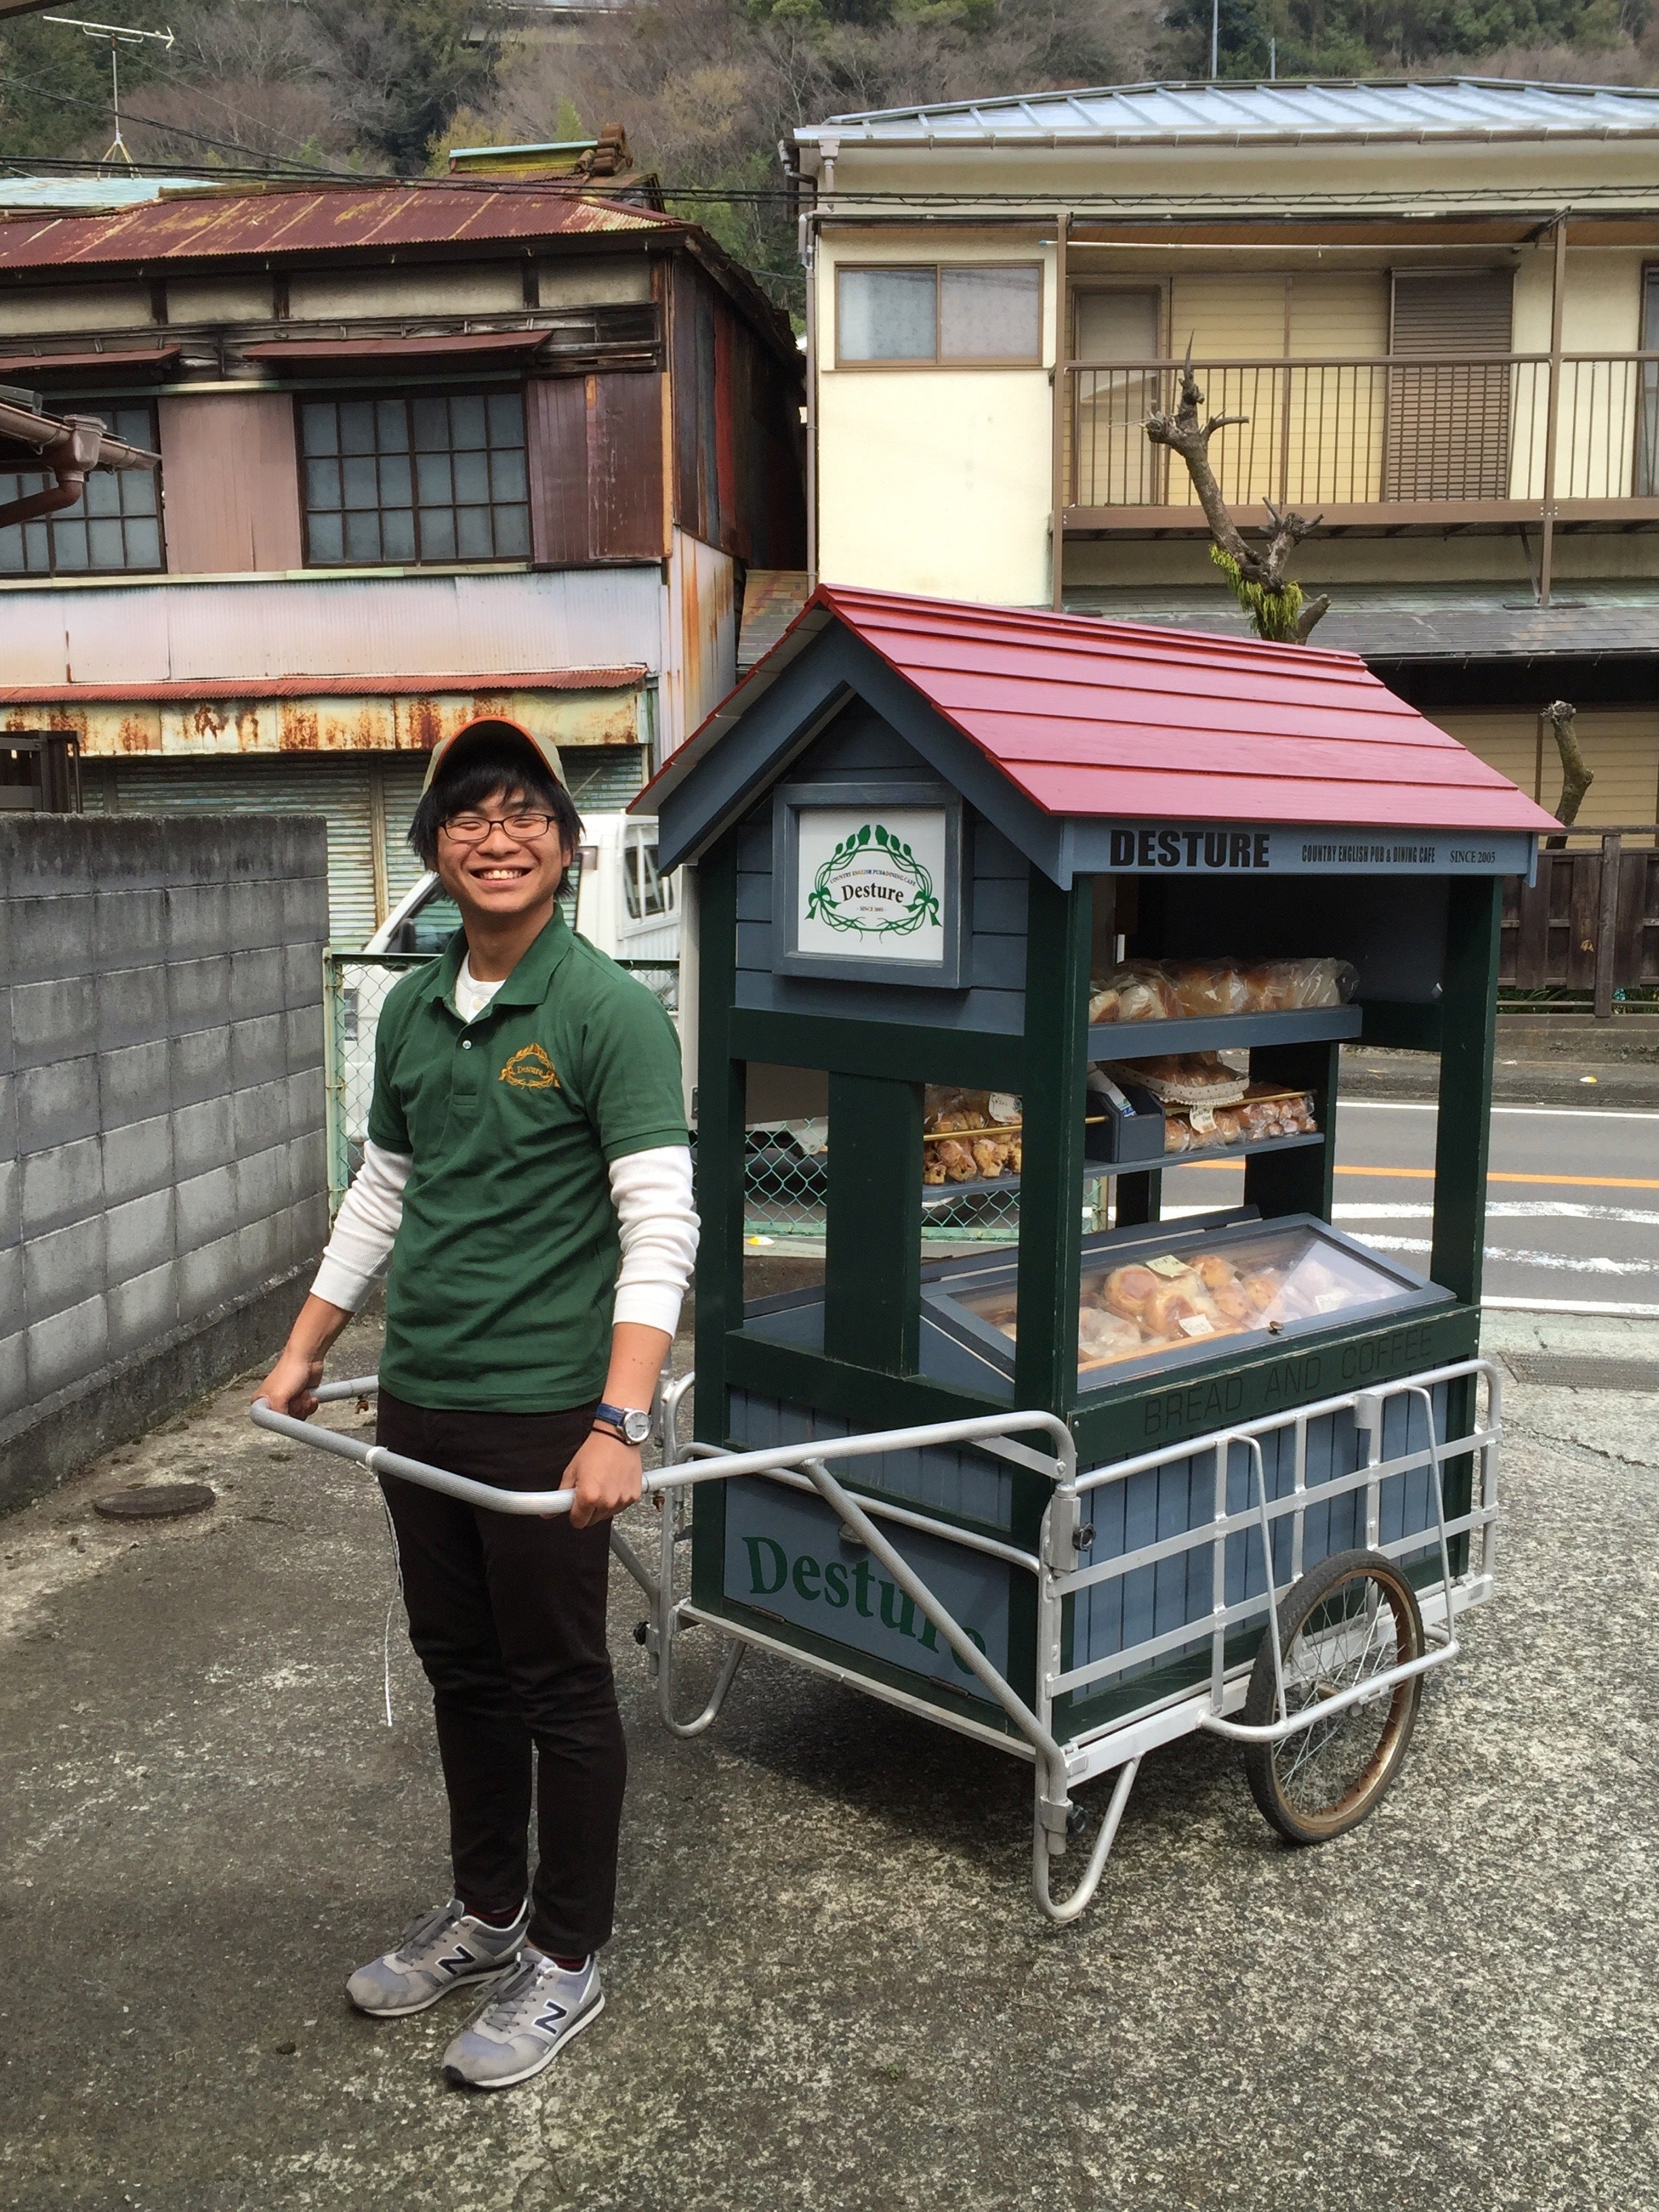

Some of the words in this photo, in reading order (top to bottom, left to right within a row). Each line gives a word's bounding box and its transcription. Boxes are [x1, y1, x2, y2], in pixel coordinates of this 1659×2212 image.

[1109, 830, 1270, 868] DESTURE
[1302, 844, 1336, 863] COUNTRY
[1338, 845, 1368, 863] ENGLISH
[1370, 846, 1385, 863] PUB
[1387, 848, 1391, 862] &
[1393, 846, 1417, 863] DINING
[1419, 846, 1435, 863] CAFE
[1450, 850, 1476, 863] SINCE
[1478, 851, 1496, 863] 2005
[841, 882, 904, 903] Desture
[1144, 1376, 1244, 1437] BREAD
[1265, 1357, 1322, 1402] AND
[1342, 1325, 1433, 1380] COFFEE
